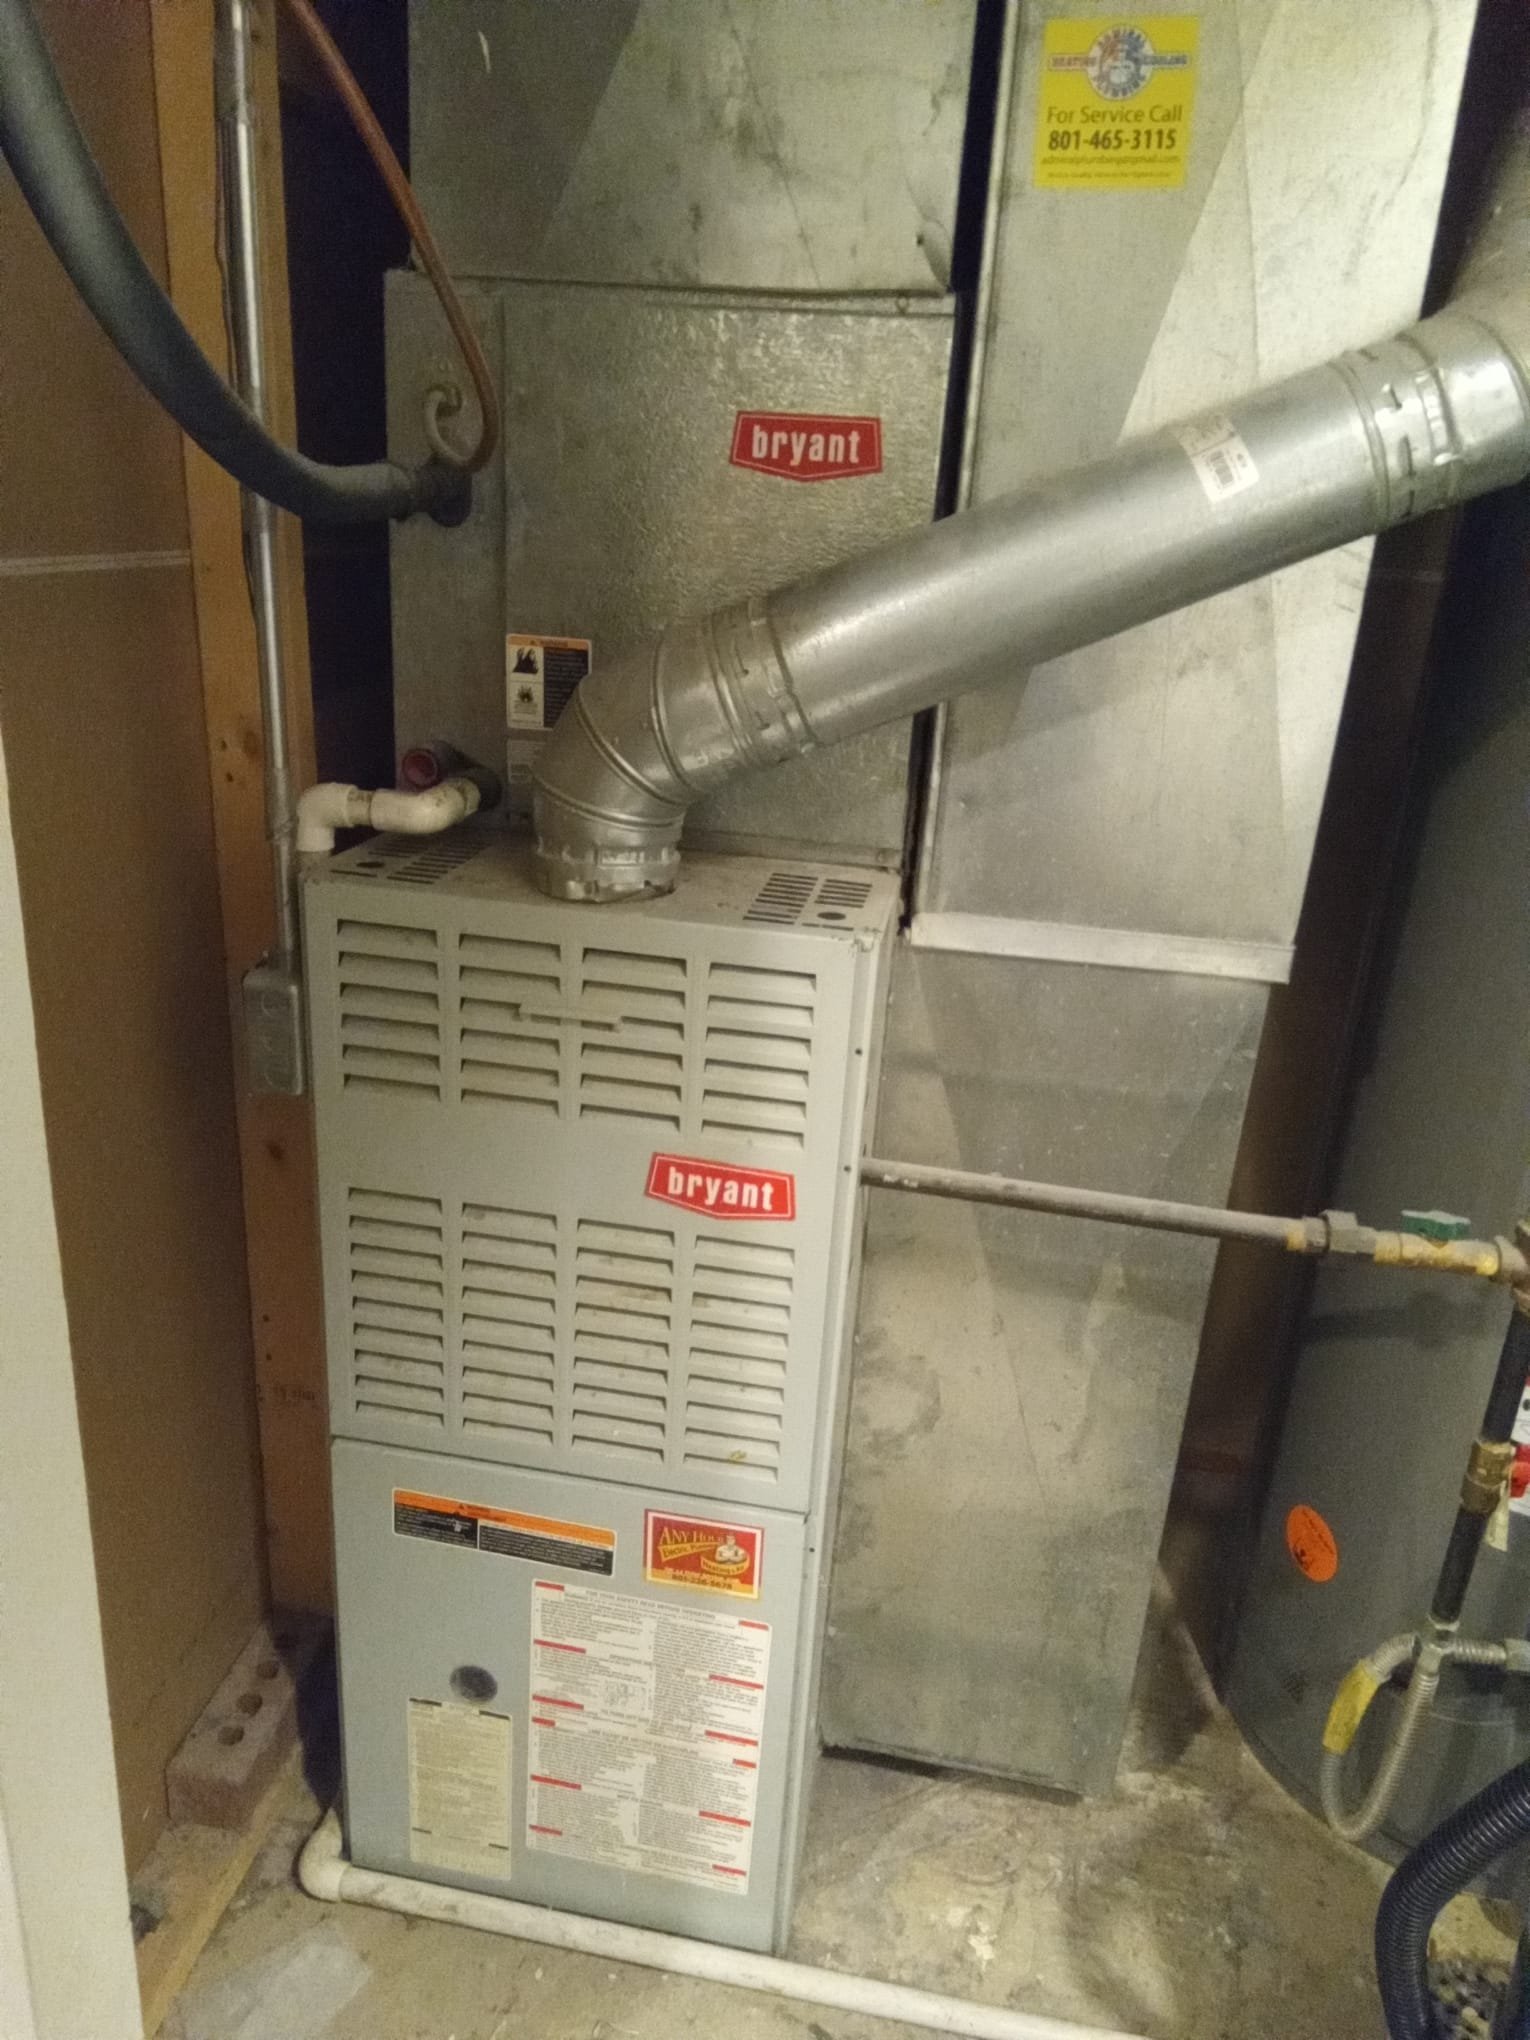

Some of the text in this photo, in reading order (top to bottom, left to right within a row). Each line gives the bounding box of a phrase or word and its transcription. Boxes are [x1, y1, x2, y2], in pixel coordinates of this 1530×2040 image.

[1047, 104, 1183, 124] For Service Call
[1048, 129, 1177, 151] 801-465-3115
[752, 424, 861, 467] bryant
[667, 1166, 774, 1212] bryant
